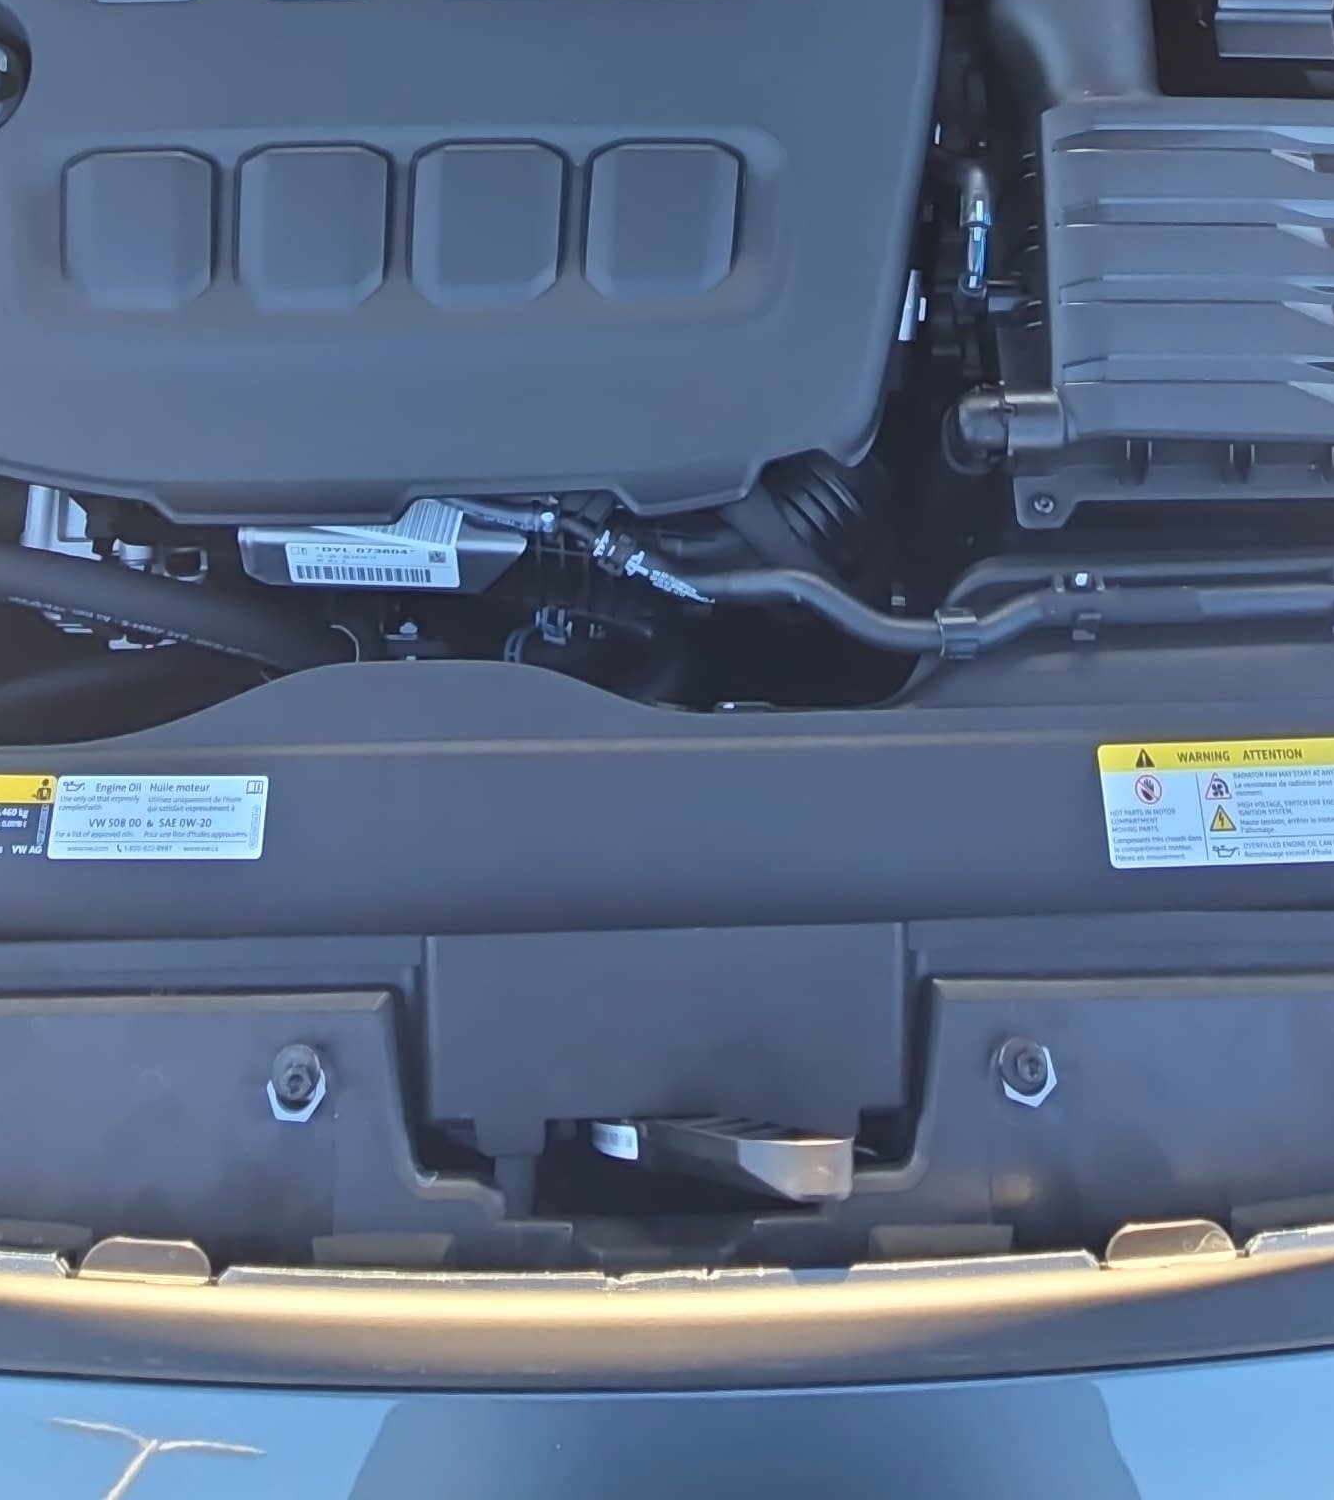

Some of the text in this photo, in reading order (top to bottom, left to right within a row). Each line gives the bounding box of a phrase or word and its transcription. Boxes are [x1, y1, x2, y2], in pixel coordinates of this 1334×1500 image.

[1177, 748, 1302, 763] WARNING ATTENTION
[96, 782, 141, 794] Engine Oil
[150, 783, 210, 792] Huile moteur
[89, 818, 106, 828] VW
[108, 818, 125, 827] 508
[129, 818, 141, 827] 00
[159, 818, 177, 828] SAE
[179, 818, 212, 827] 0W-20
[12, 845, 27, 854] VW
[29, 845, 43, 854] AG
